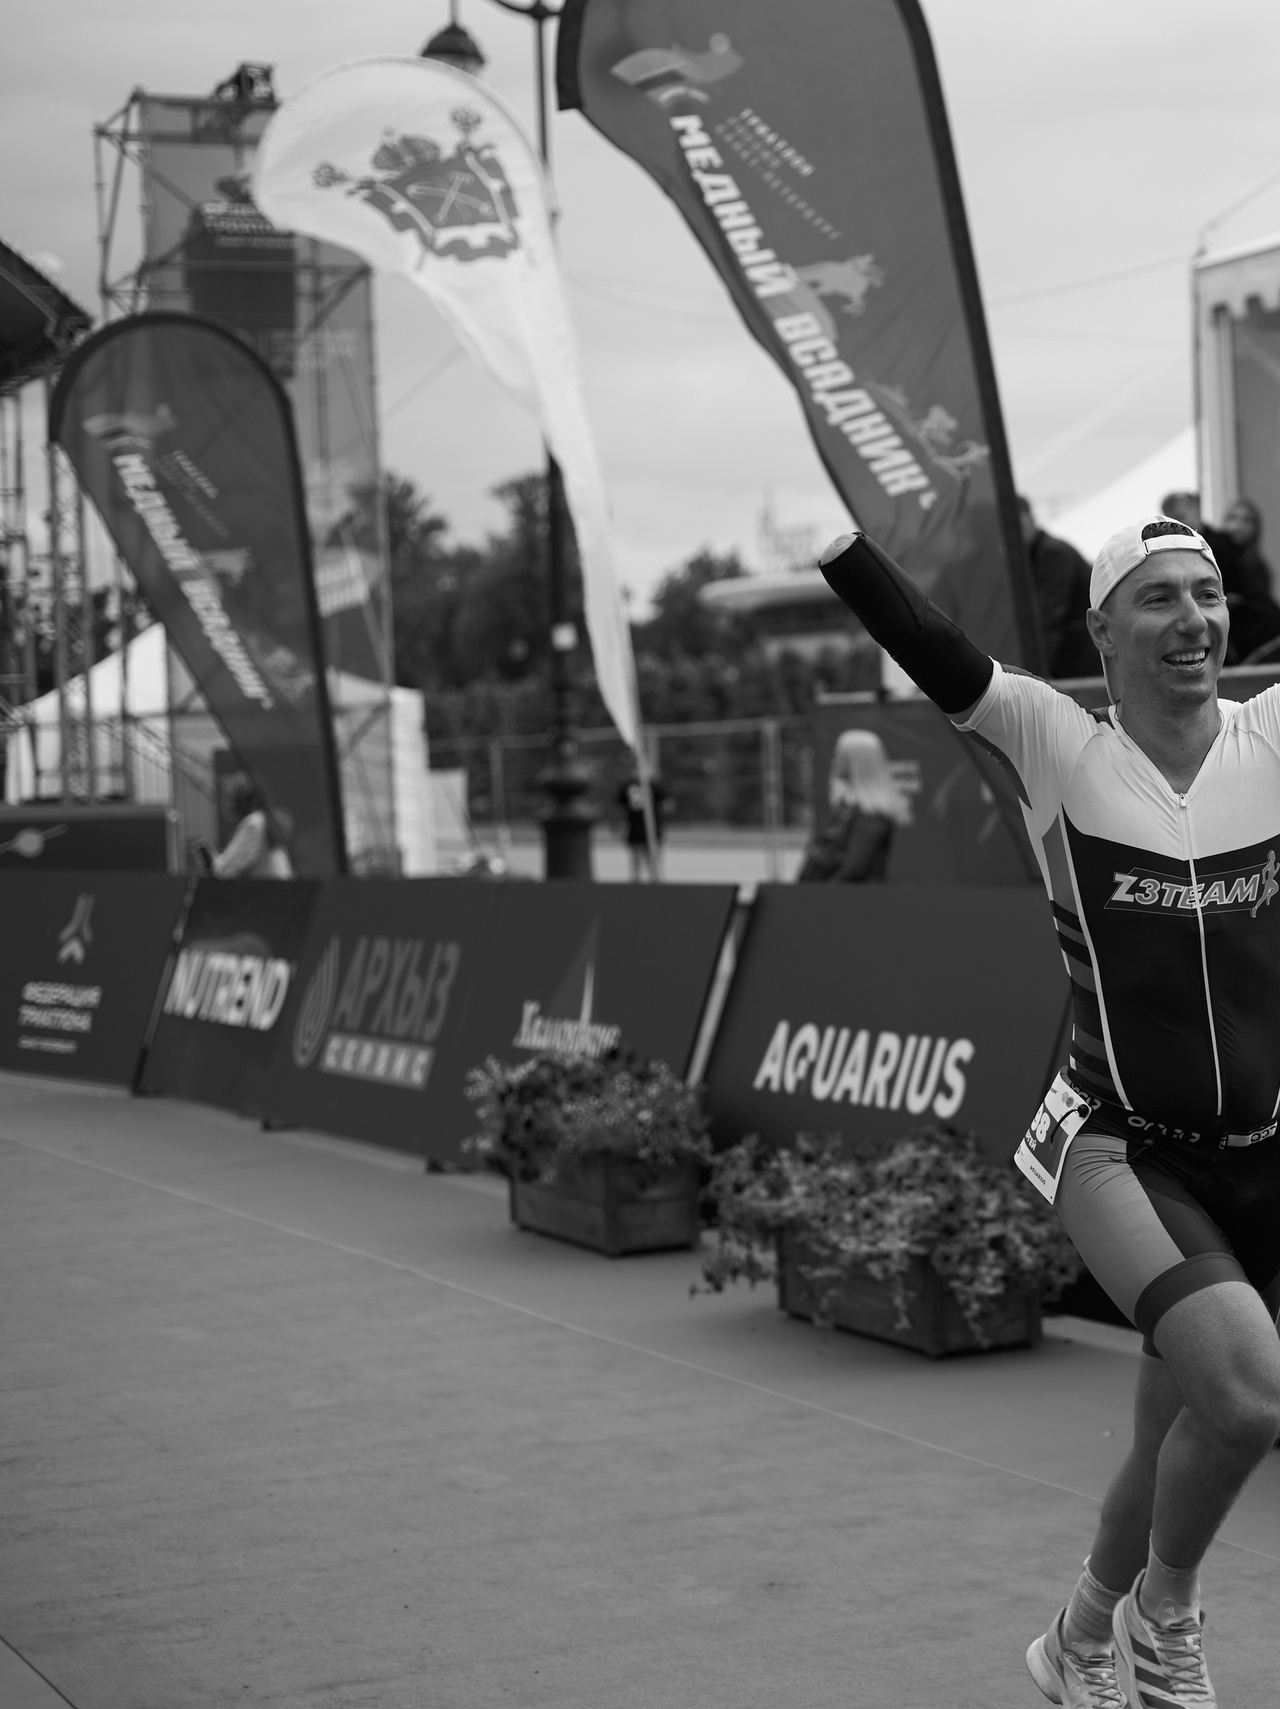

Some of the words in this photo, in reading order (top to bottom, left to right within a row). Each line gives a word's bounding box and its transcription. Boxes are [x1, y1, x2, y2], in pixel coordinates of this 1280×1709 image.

[669, 114, 799, 299] МЕДНЫЙ
[773, 311, 930, 497] ВСАДНИК
[1111, 871, 1260, 909] Z3TEAM
[164, 947, 290, 1031] NUTREND
[333, 935, 461, 1042] АРХЫЗ
[752, 1019, 975, 1120] AQUARIUS
